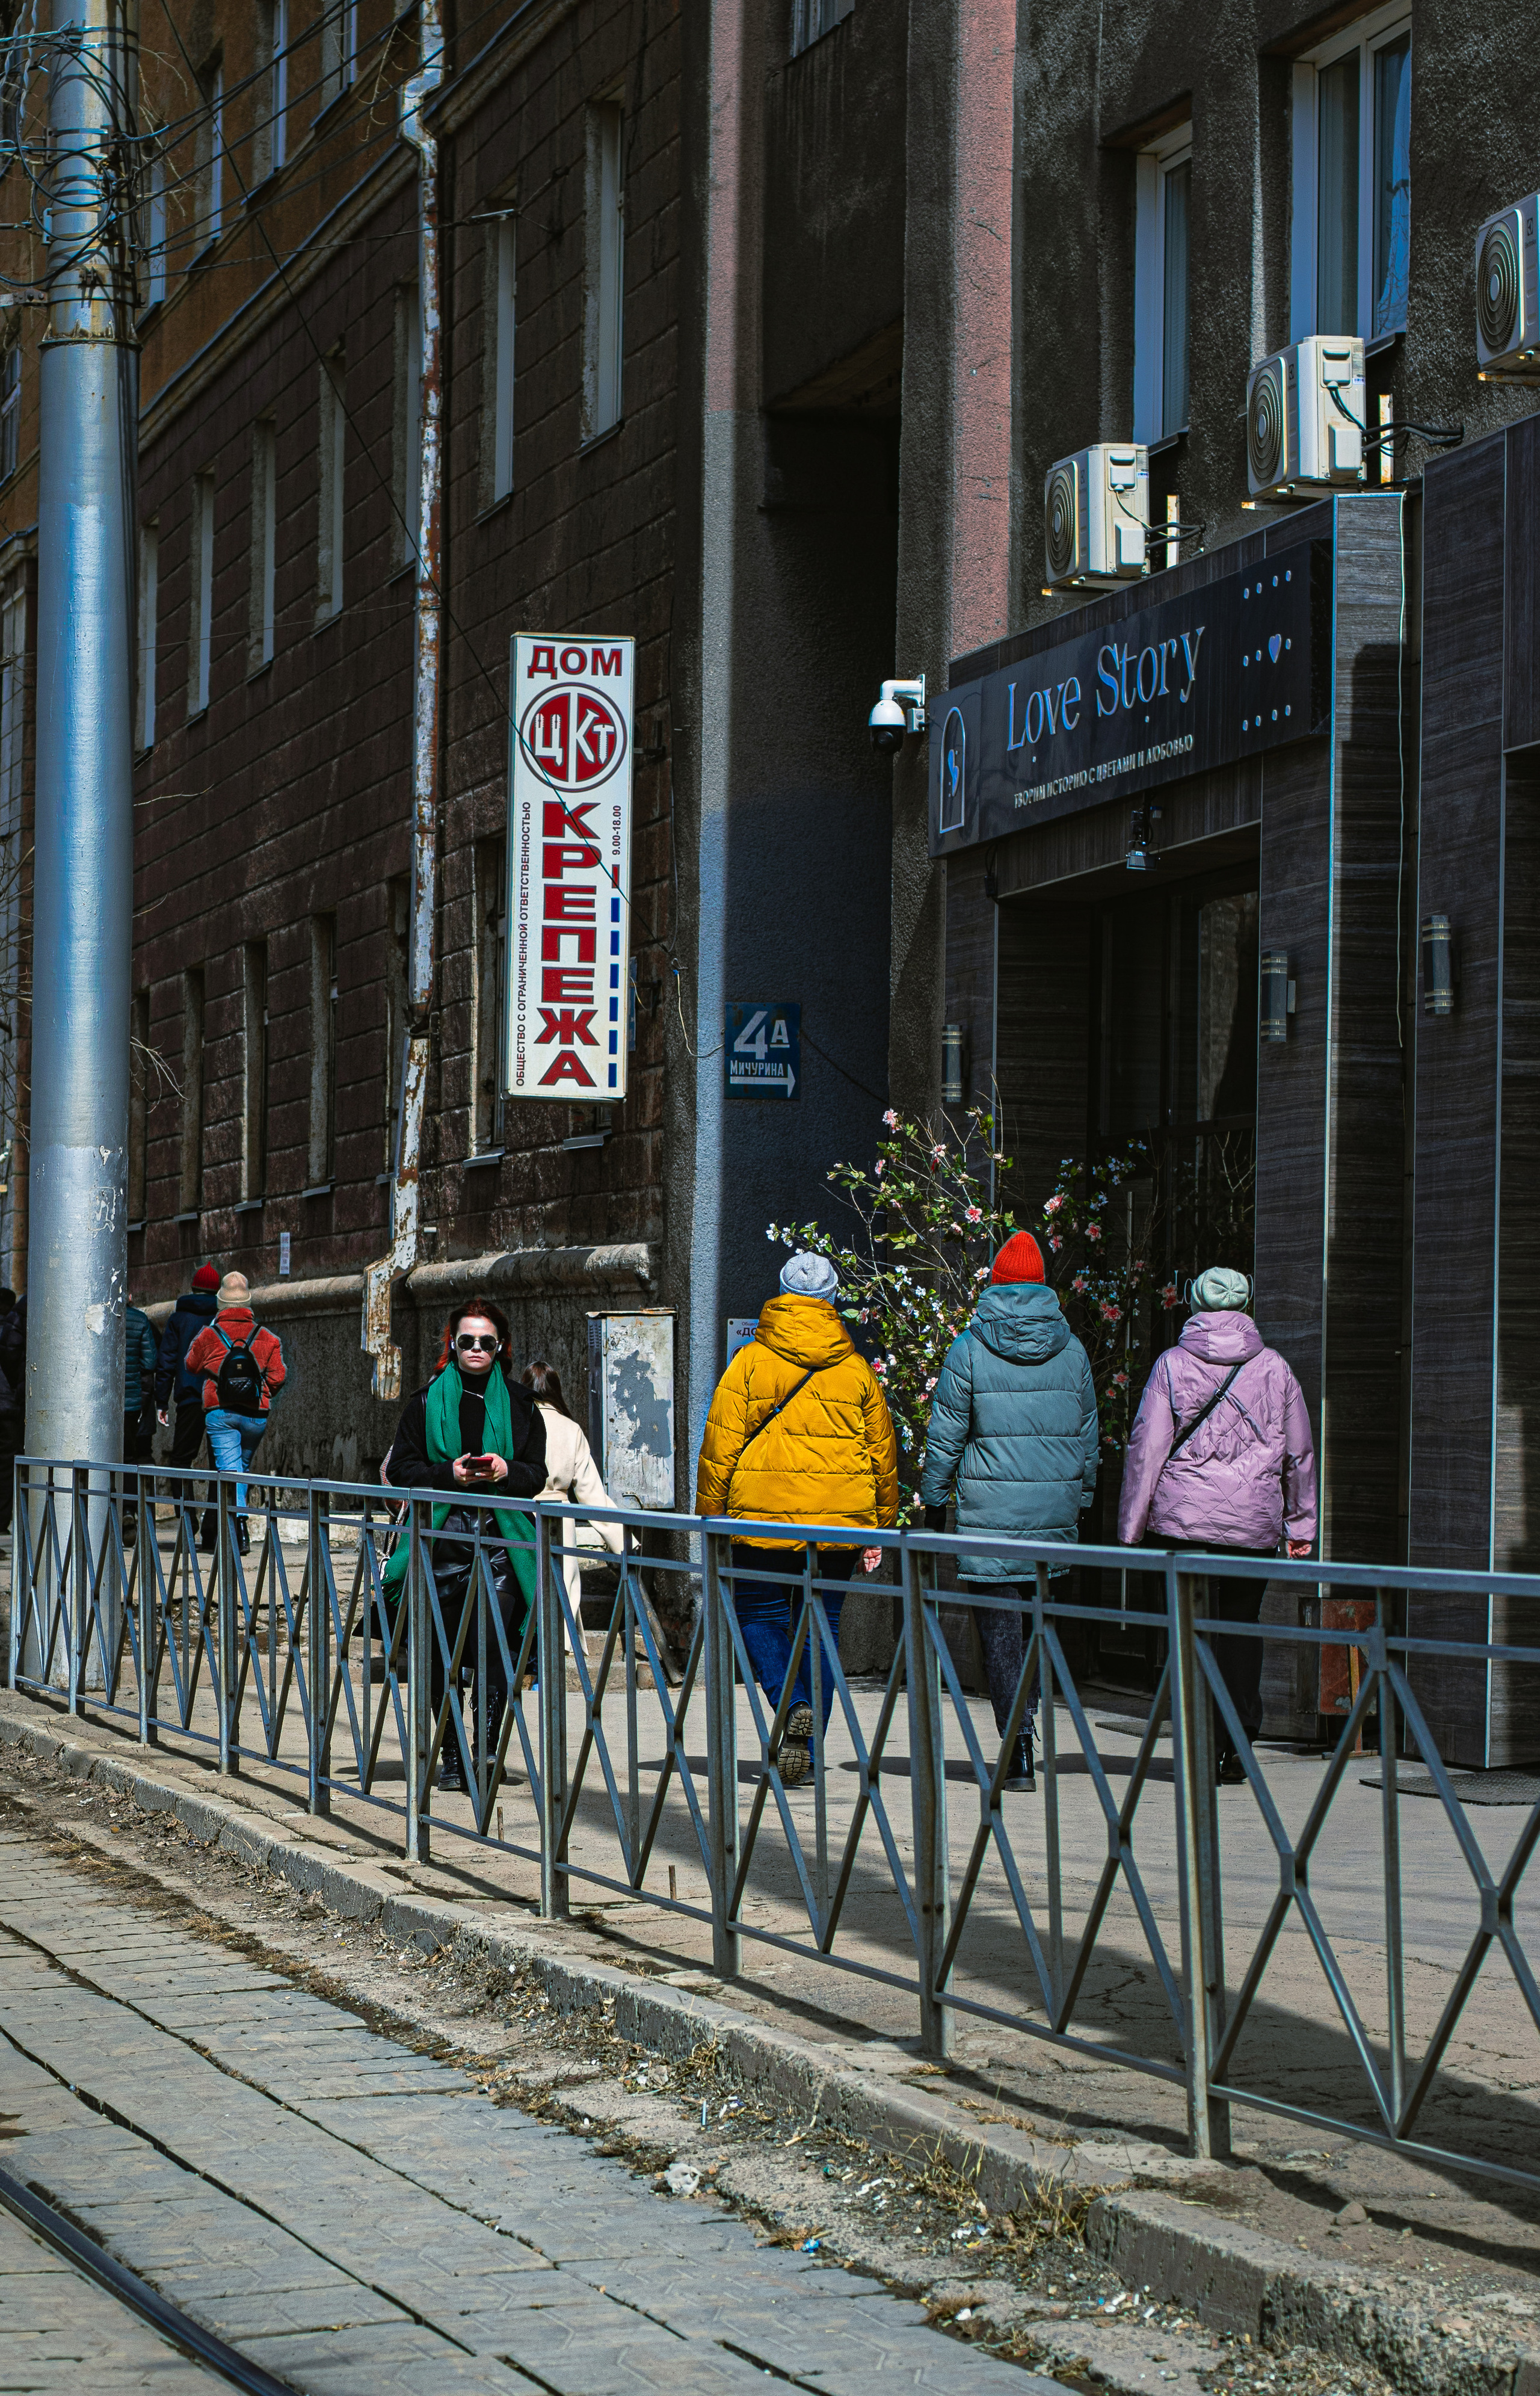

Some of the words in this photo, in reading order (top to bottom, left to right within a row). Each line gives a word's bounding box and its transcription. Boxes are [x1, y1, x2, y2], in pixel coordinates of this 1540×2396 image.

[527, 644, 623, 680] ДОМ
[1006, 676, 1081, 751] Love
[1095, 626, 1206, 717] Story
[1014, 784, 1046, 809] ТВОРИМ
[1047, 770, 1087, 797] ИСТОРИЮ
[1088, 767, 1095, 783] С
[1096, 753, 1136, 782] ЦВЕТАМИ
[1138, 750, 1144, 767] И
[1145, 733, 1194, 765] ЛЮБОВЬЮ
[520, 801, 531, 921] ОТВЕТСТВЕННОСТЬЮ
[612, 804, 621, 856] 9.00-18.00
[517, 923, 528, 1011] ОГРАНИЧЕННОЙ
[534, 800, 602, 1087] КРЕПЕЖА
[517, 1013, 526, 1022] С
[516, 1024, 526, 1087] ОБЩЕСТВО
[736, 1327, 757, 1337] «ДО
